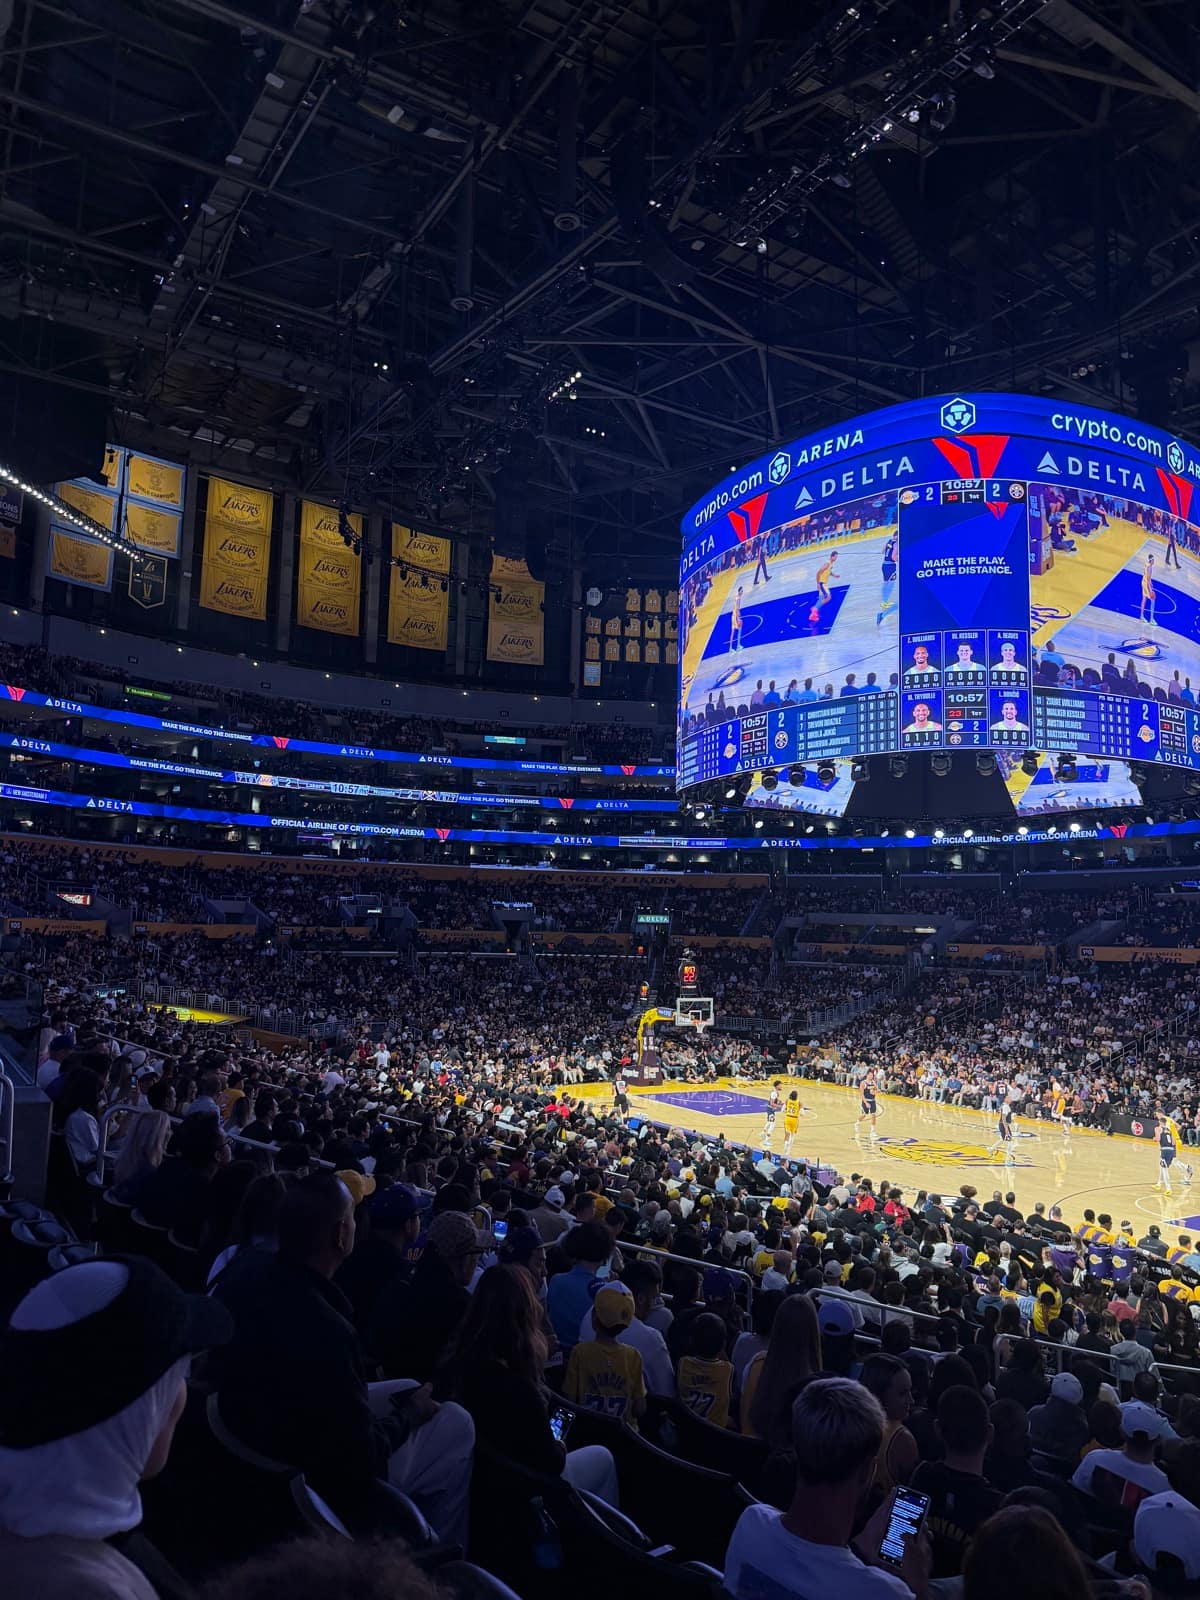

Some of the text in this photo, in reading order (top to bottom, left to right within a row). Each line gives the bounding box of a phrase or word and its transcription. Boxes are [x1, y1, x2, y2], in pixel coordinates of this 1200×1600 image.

[1052, 414, 1161, 458] crypto.com
[695, 430, 864, 528] crypto.com ARENA
[822, 456, 914, 498] DELTA
[1068, 456, 1146, 492] DELTA
[926, 480, 980, 501] 2 10:57
[992, 484, 1000, 496] 2
[222, 497, 259, 517] LAKERS
[219, 539, 256, 559] LAKERS
[406, 539, 439, 554] LAKERS
[683, 534, 715, 574] DELTA
[314, 560, 348, 578] LAKERS
[923, 557, 1006, 568] MAKE THE PLAY.
[916, 566, 1012, 578] GO THE DISTANCE.
[216, 582, 253, 602] LAKERS
[312, 601, 346, 618] LAKERS
[402, 618, 435, 634] LAKERS
[500, 634, 534, 649] LAKERS
[948, 694, 984, 702] 10:57
[55, 700, 82, 712] DELTA
[1142, 704, 1198, 731] 2 10:57 2
[162, 721, 178, 729] MAKE
[728, 712, 785, 739] 2 10:57 2
[974, 721, 979, 731] 2
[21, 740, 51, 752] DELTA
[974, 734, 979, 744] 2
[349, 749, 375, 757] DELTA
[428, 756, 452, 764] DELTA
[1165, 752, 1193, 766] DELTA
[130, 759, 147, 767] MAKE
[744, 756, 774, 768] DELTA
[333, 784, 359, 794] 10:57
[98, 800, 133, 811] DELTA
[271, 819, 305, 828] OFFICIAL
[307, 822, 337, 830] AIRLINE
[350, 825, 398, 835] CRYPTO.COM
[400, 828, 425, 836] ARENA
[1015, 832, 1068, 841] CRYPTO.COM
[1070, 830, 1098, 838] ARENA
